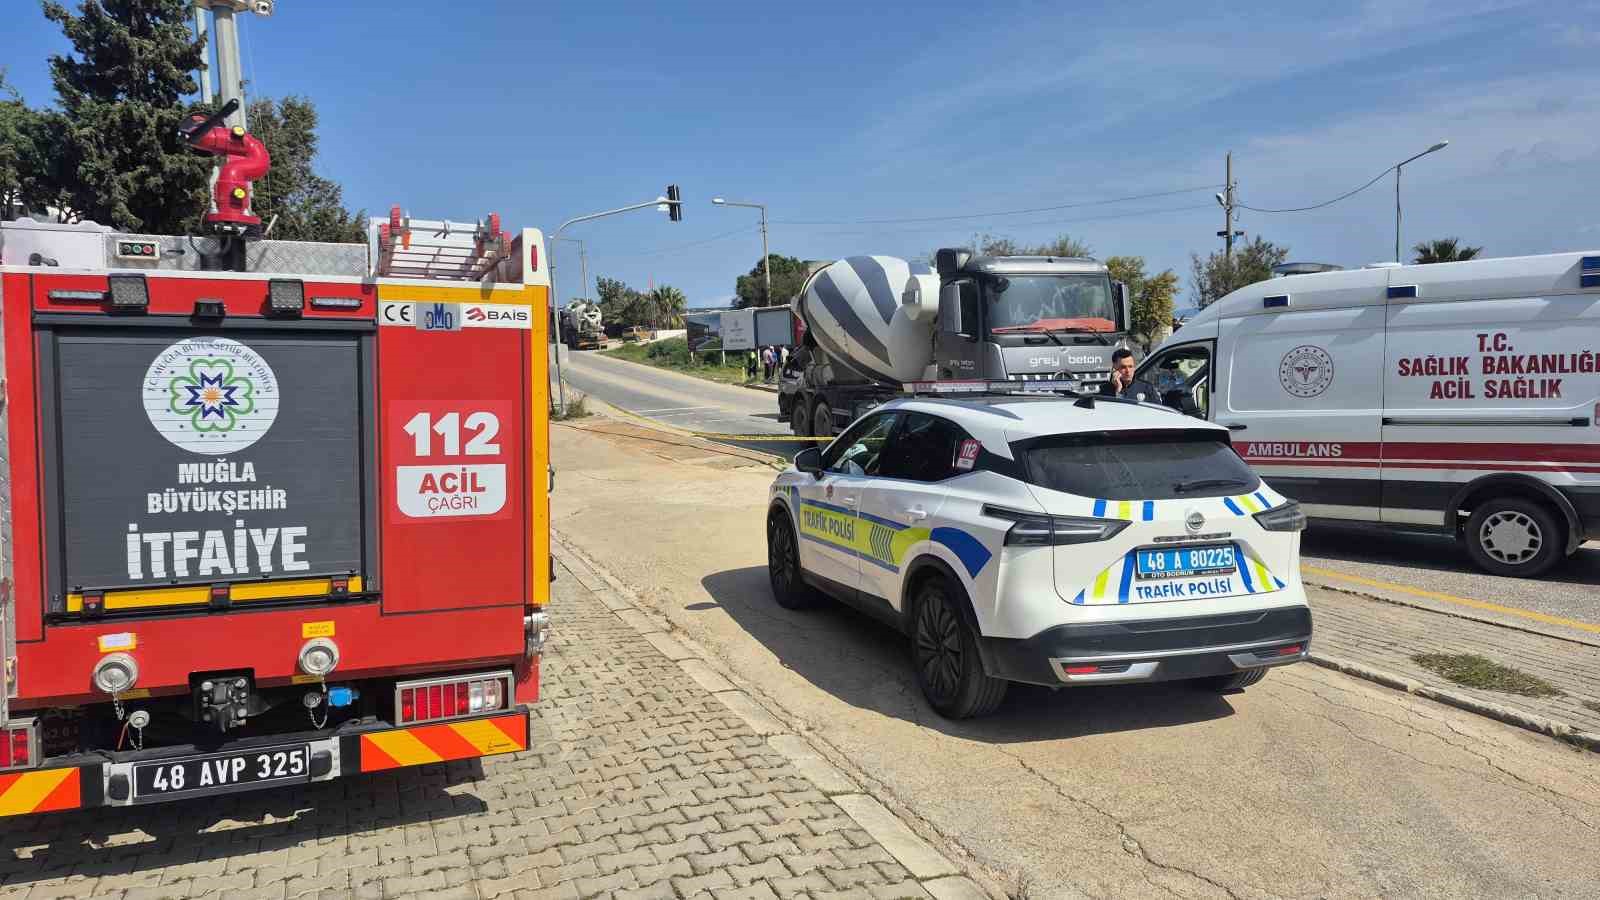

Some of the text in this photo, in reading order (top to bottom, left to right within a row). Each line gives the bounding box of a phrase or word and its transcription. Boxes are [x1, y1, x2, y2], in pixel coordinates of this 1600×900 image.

[1476, 333, 1514, 353] T.C.
[1068, 354, 1102, 364] beton
[1398, 355, 1469, 376] SAĞLIK
[1430, 376, 1562, 399] ACİL SAĞLIK
[403, 411, 500, 456] 112
[962, 443, 977, 458] 112
[1247, 443, 1342, 456] AMBULANS
[178, 458, 256, 484] MUĞLA
[419, 467, 486, 494] ACİL
[147, 485, 287, 515] BÜYÜKŞEHİR
[427, 494, 477, 514] ÇAĞRI
[803, 510, 854, 542] TRAFİK POLİSİ
[126, 519, 310, 580] İTFAİYE
[1148, 548, 1233, 571] 48 A 80225
[1136, 577, 1232, 599] TRAFİK POLİSİ
[153, 750, 304, 791] 48 AVP 325
